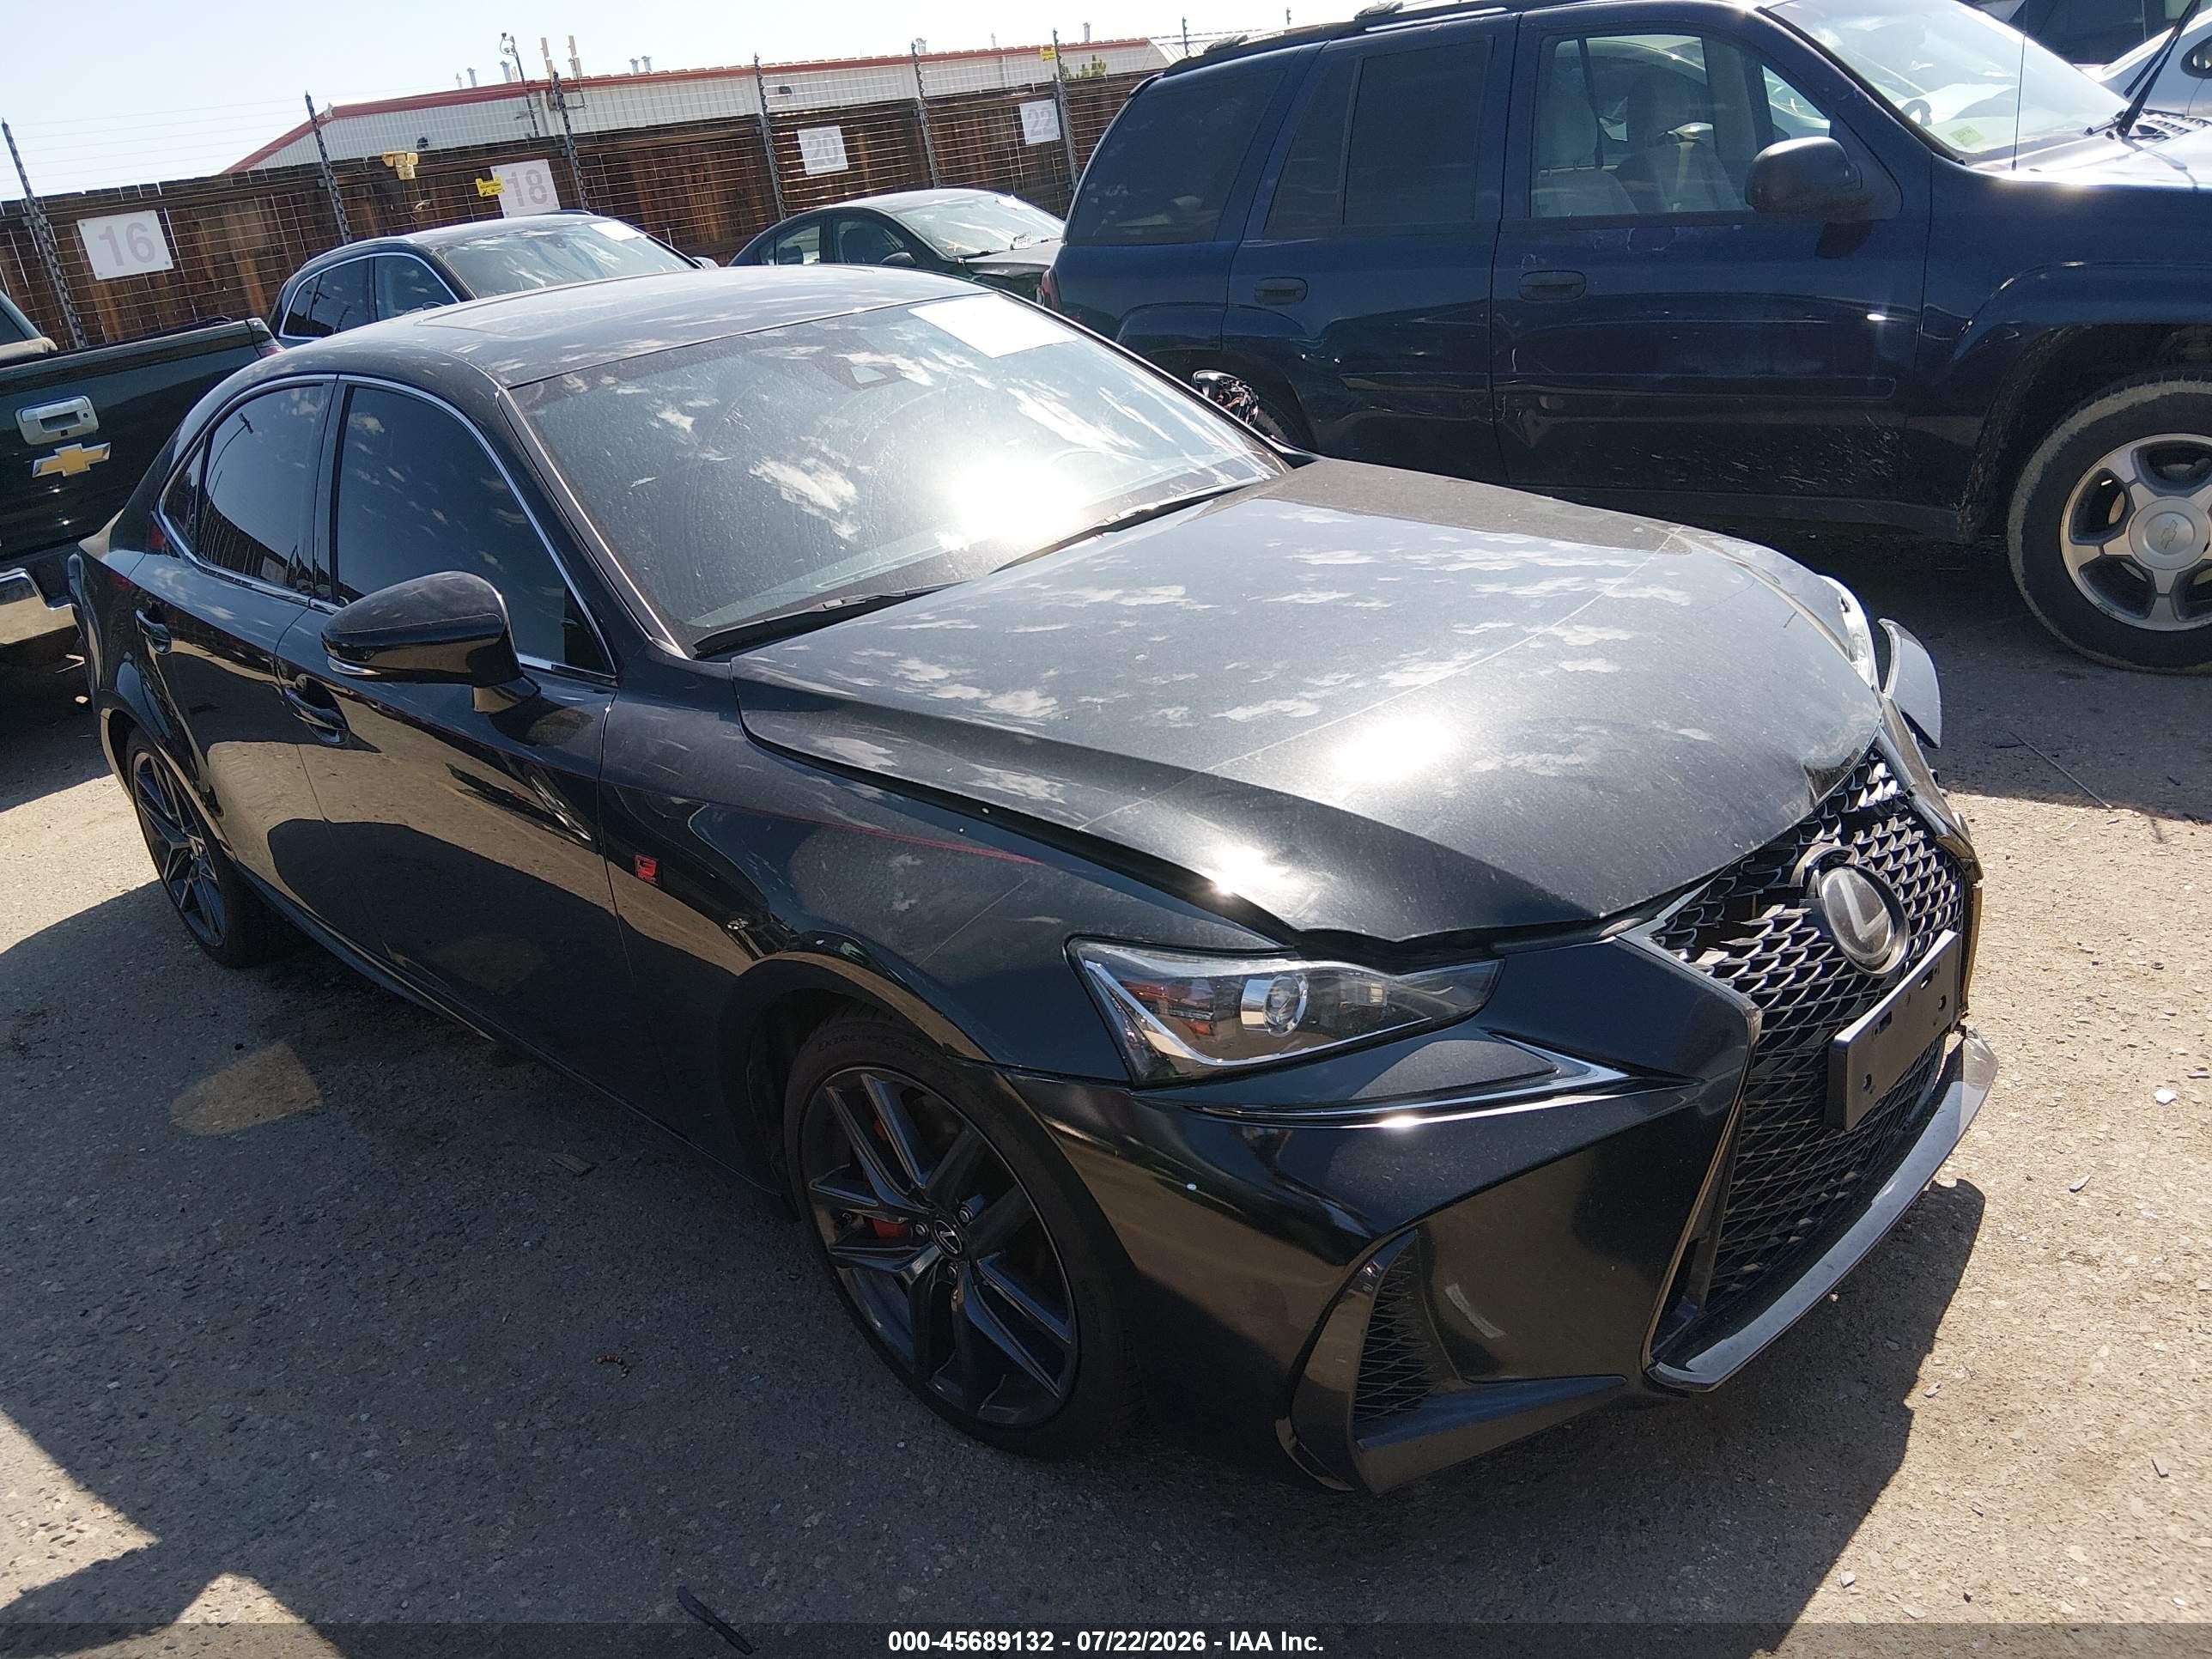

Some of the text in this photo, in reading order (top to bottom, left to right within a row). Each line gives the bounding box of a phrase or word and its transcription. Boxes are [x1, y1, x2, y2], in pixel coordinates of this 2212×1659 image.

[1027, 106, 1054, 137] 22
[808, 132, 839, 167] 20
[506, 168, 548, 207] 18
[98, 222, 156, 267] 16
